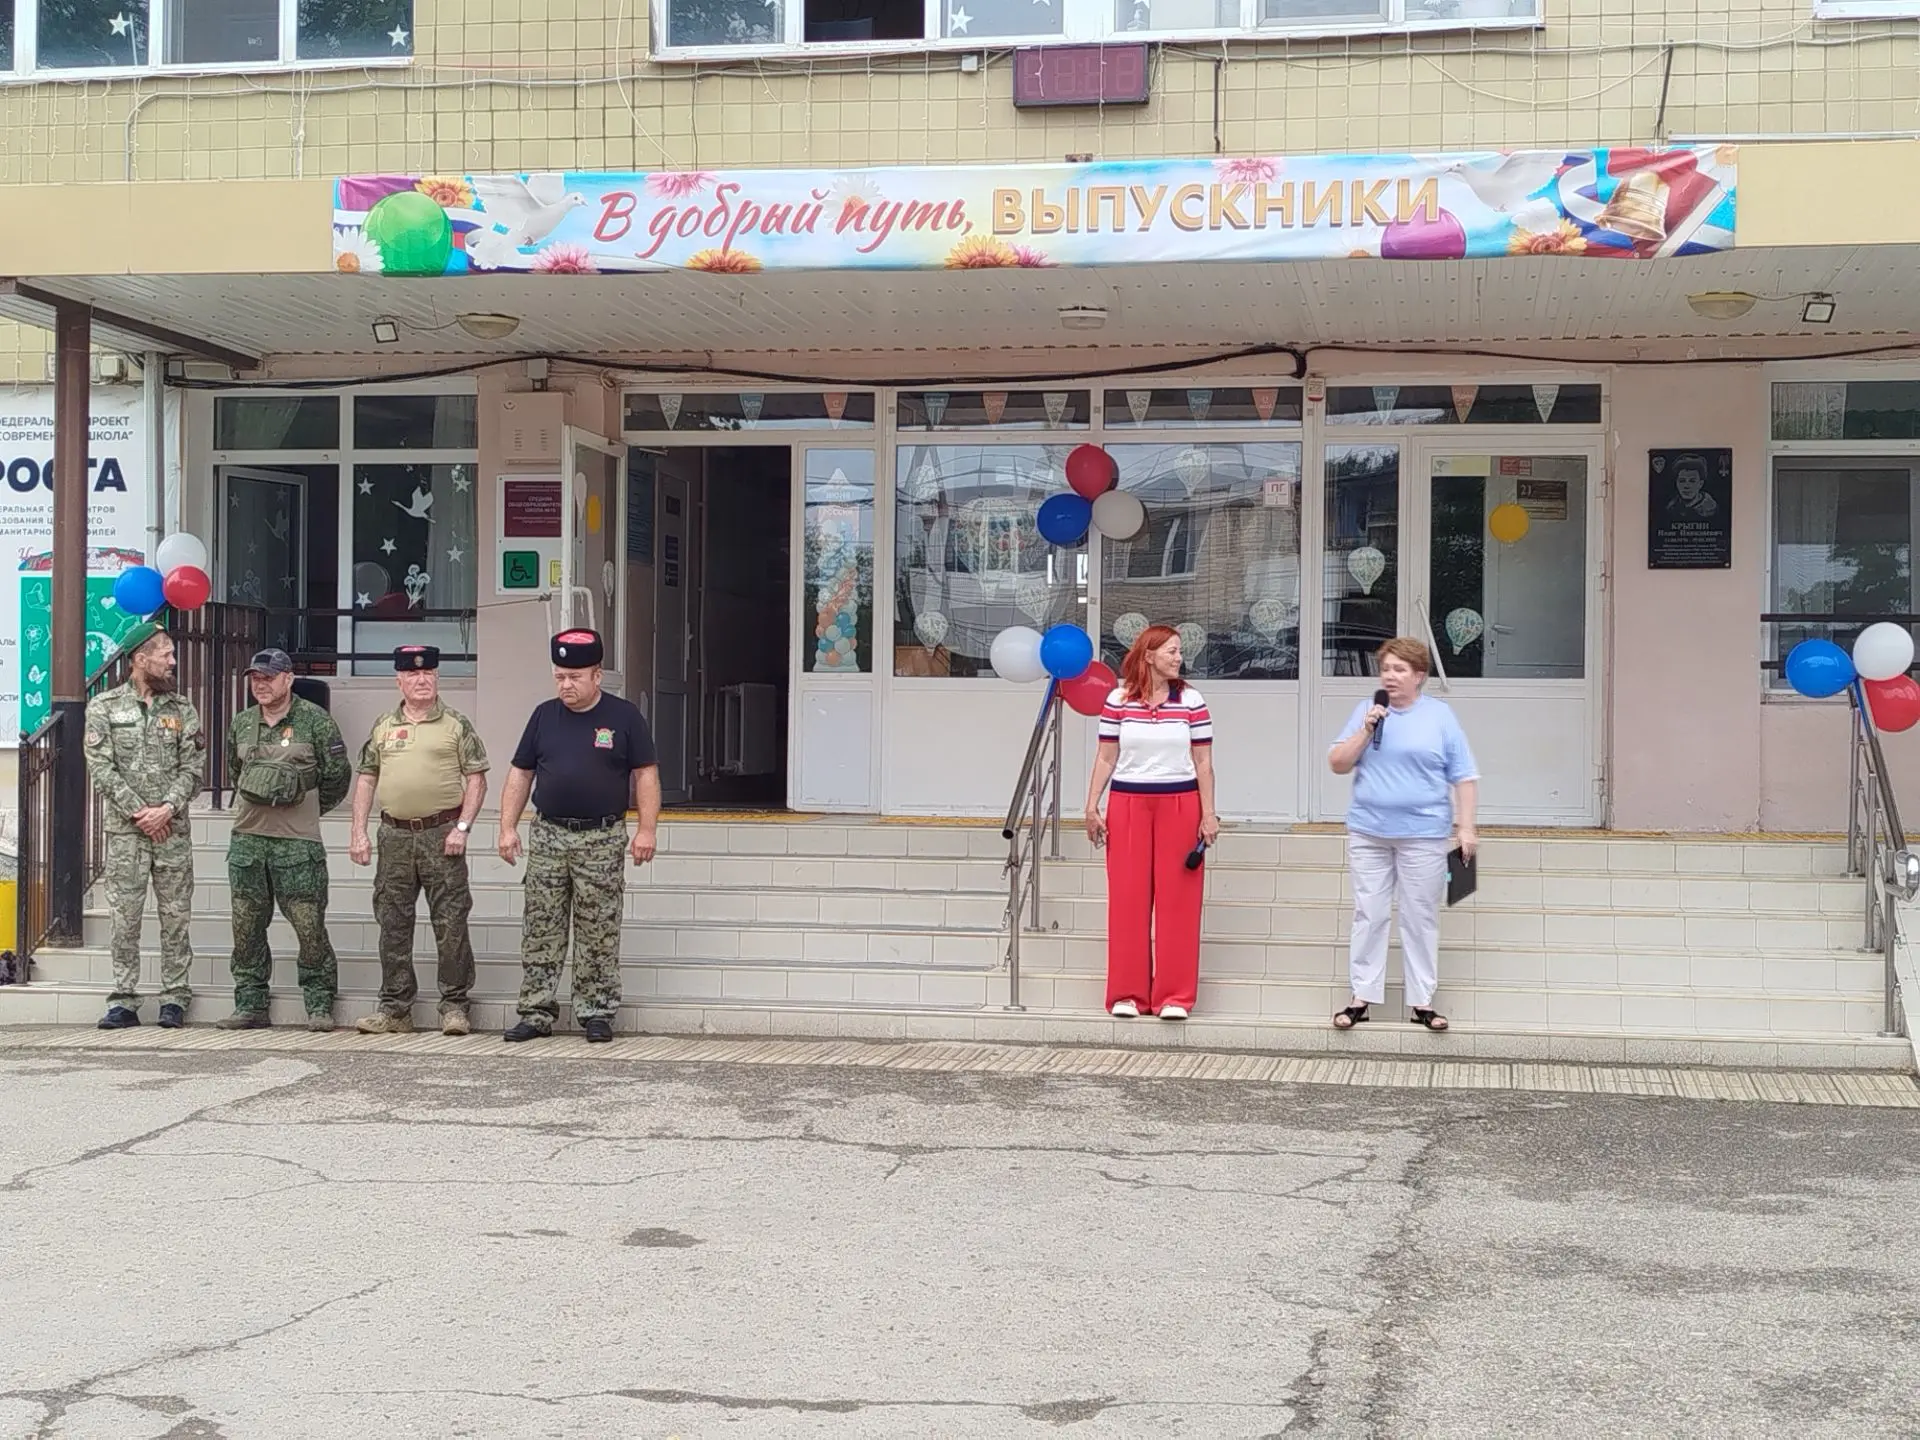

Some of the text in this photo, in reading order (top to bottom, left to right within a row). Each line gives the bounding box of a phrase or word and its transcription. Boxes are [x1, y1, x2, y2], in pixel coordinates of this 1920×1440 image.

[593, 176, 1441, 259] В добрый путь, ВЫПУСКНИКИ
